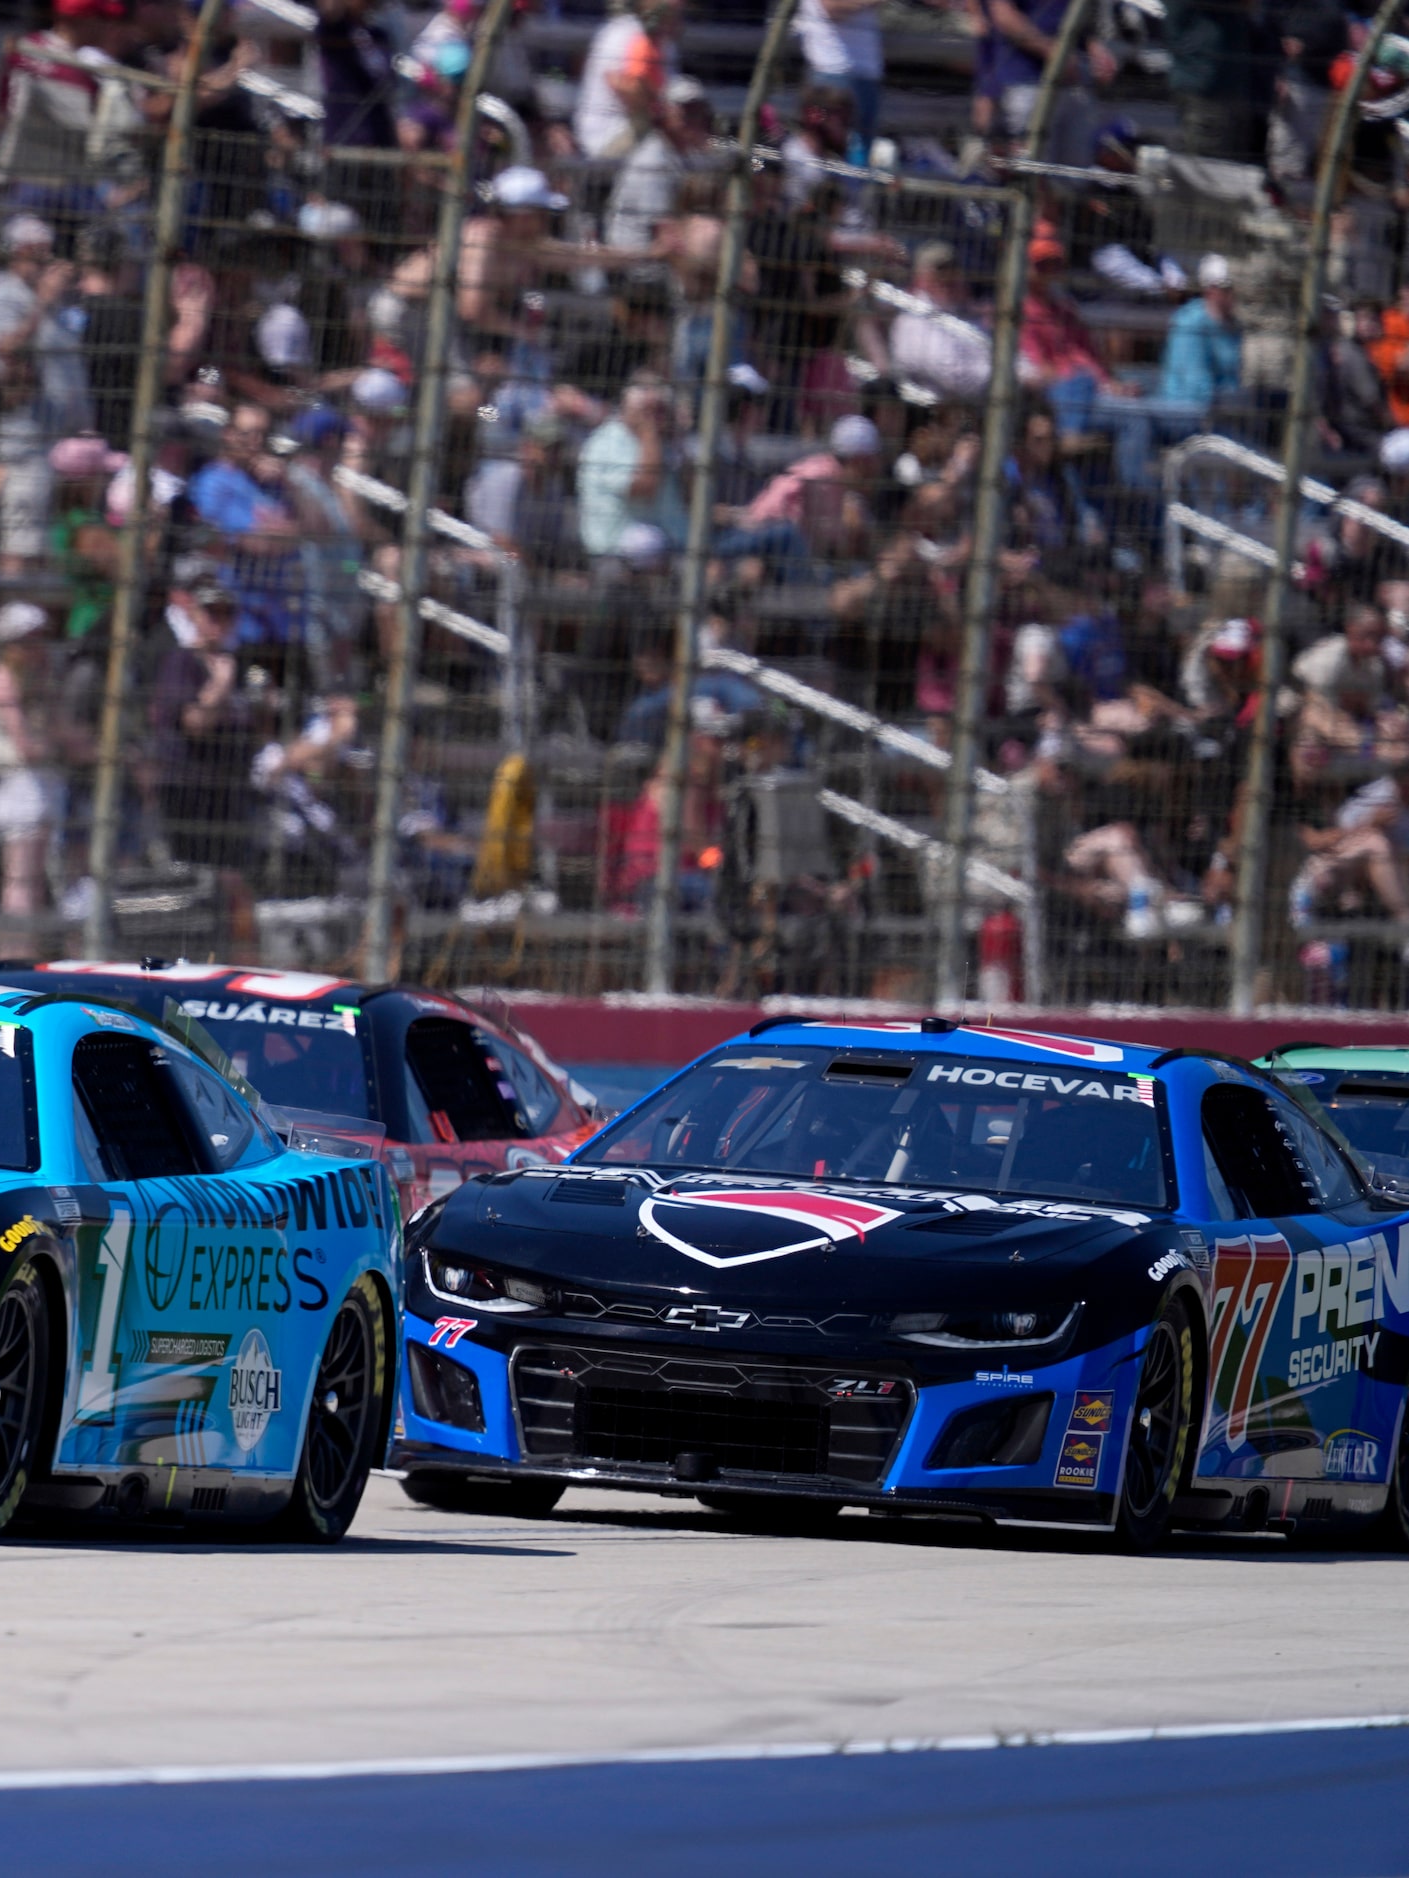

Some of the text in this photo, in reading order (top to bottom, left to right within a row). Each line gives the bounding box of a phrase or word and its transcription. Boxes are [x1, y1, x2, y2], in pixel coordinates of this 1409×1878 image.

[177, 998, 347, 1031] SUÁREZ
[927, 1064, 1142, 1101] HOCEVAR
[180, 1167, 384, 1231] WORLDWIDE
[75, 1208, 131, 1421] 1
[428, 1315, 478, 1348] 77
[1207, 1232, 1292, 1454] 77
[1288, 1331, 1381, 1388] SECURITY
[229, 1367, 280, 1411] BUSCH
[827, 1379, 896, 1395] ZL1
[235, 1411, 263, 1430] LIGHT
[1058, 1465, 1095, 1478] ROOKIE
